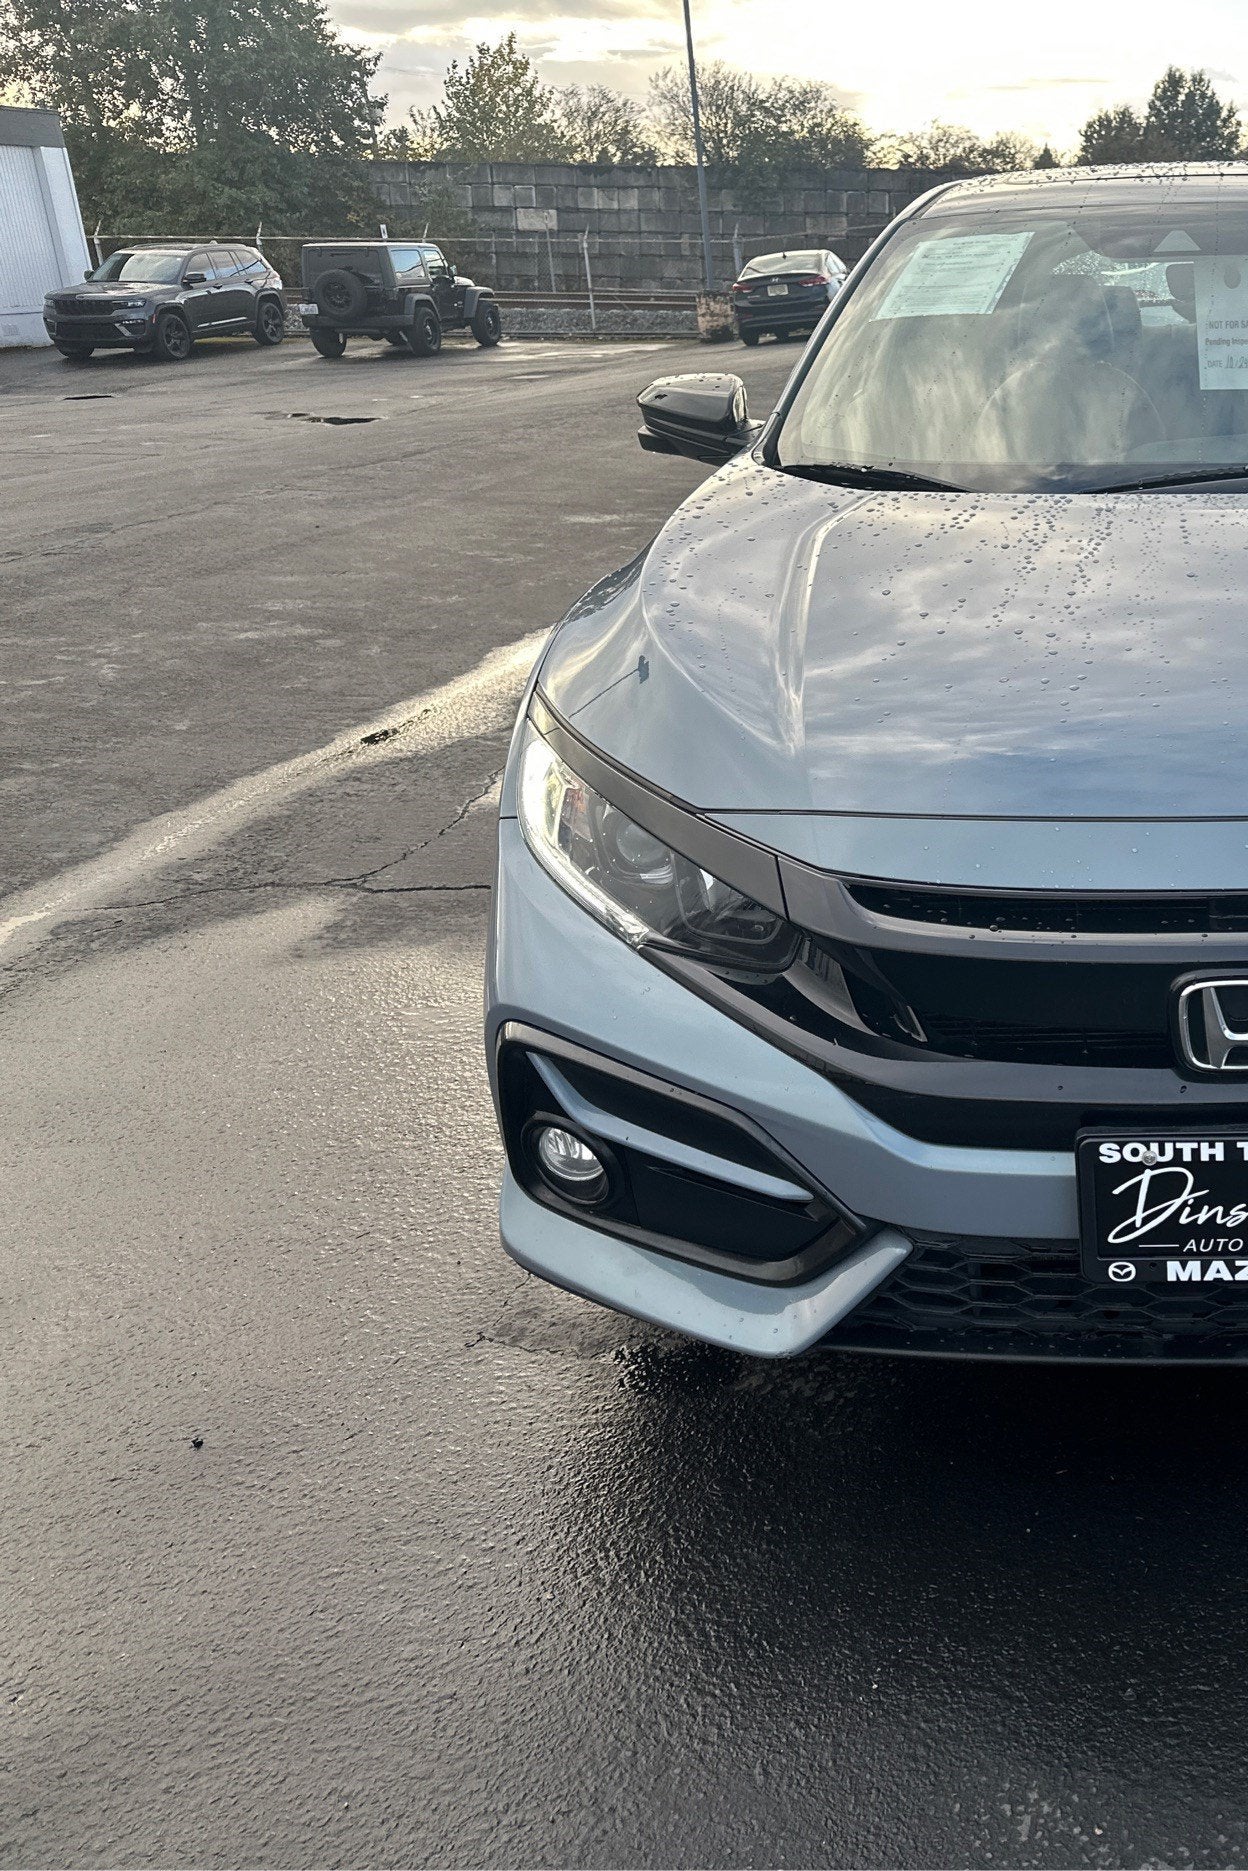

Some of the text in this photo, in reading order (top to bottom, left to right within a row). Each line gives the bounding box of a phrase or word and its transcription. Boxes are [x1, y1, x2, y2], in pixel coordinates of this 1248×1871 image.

[1208, 320, 1223, 329] NOT
[1225, 320, 1239, 329] FOR
[1205, 338, 1230, 346] Pending
[1207, 360, 1223, 368] DATE
[1099, 1142, 1224, 1164] SOUTH
[1183, 1238, 1244, 1252] AUTO
